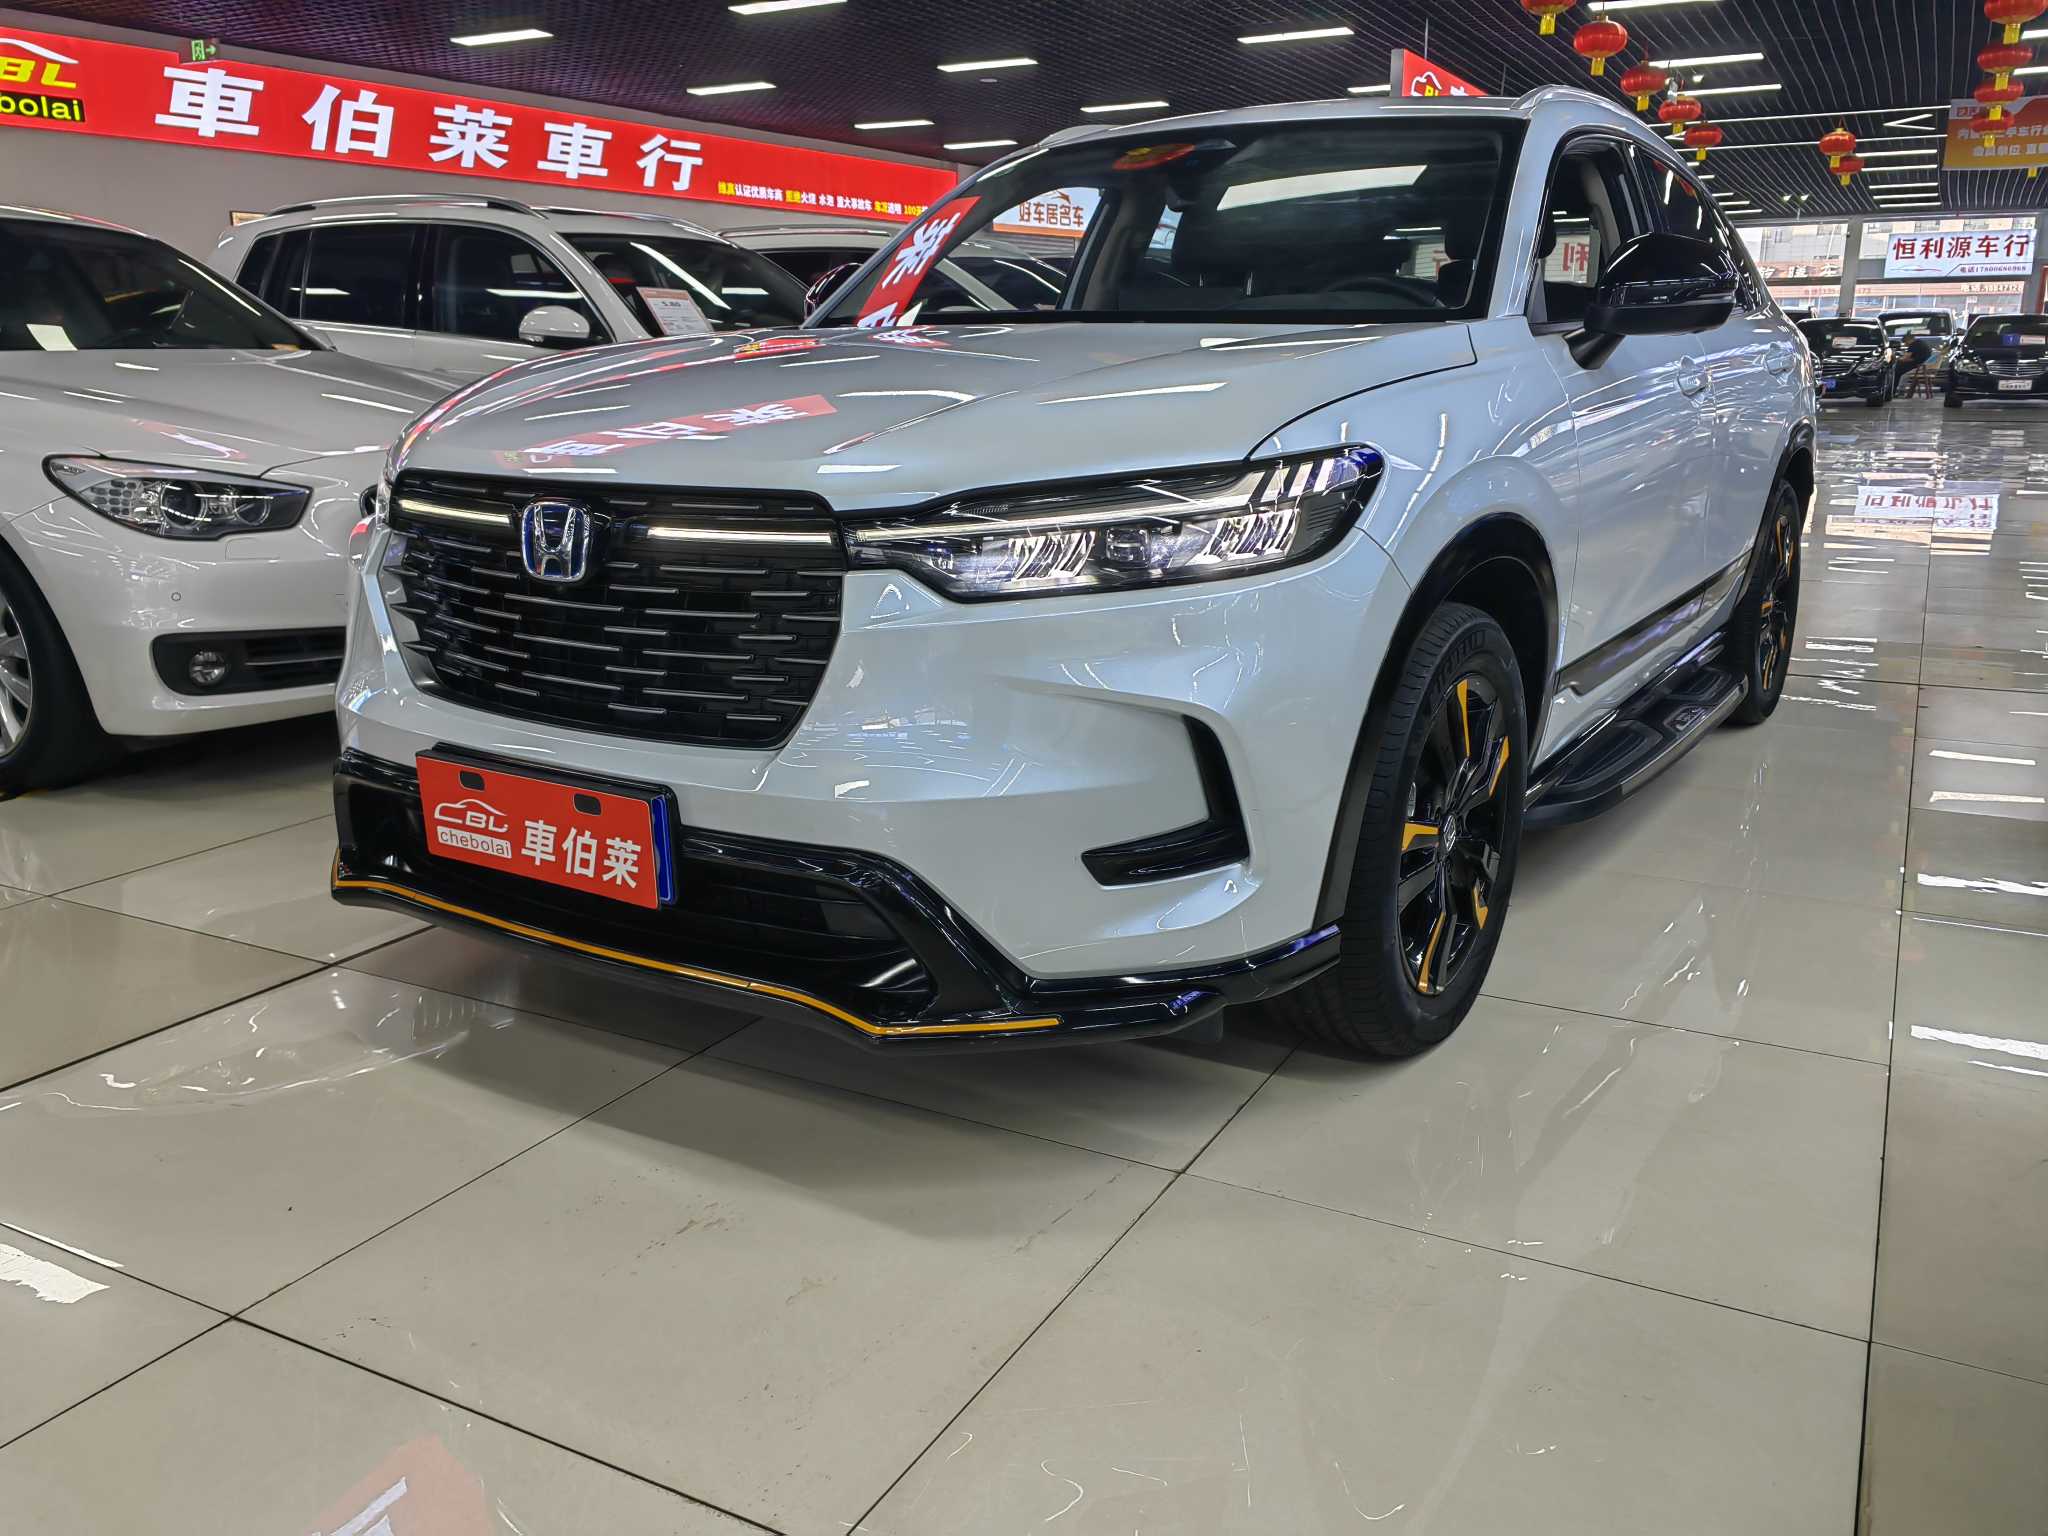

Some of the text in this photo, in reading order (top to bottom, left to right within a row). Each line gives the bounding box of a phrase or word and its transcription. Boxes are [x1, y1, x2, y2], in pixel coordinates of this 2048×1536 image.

[1018, 202, 1084, 228] 好车居名车
[1893, 234, 2029, 260] 恒利源车行
[440, 830, 511, 856] chebolai
[521, 819, 641, 889] 車伯莱
